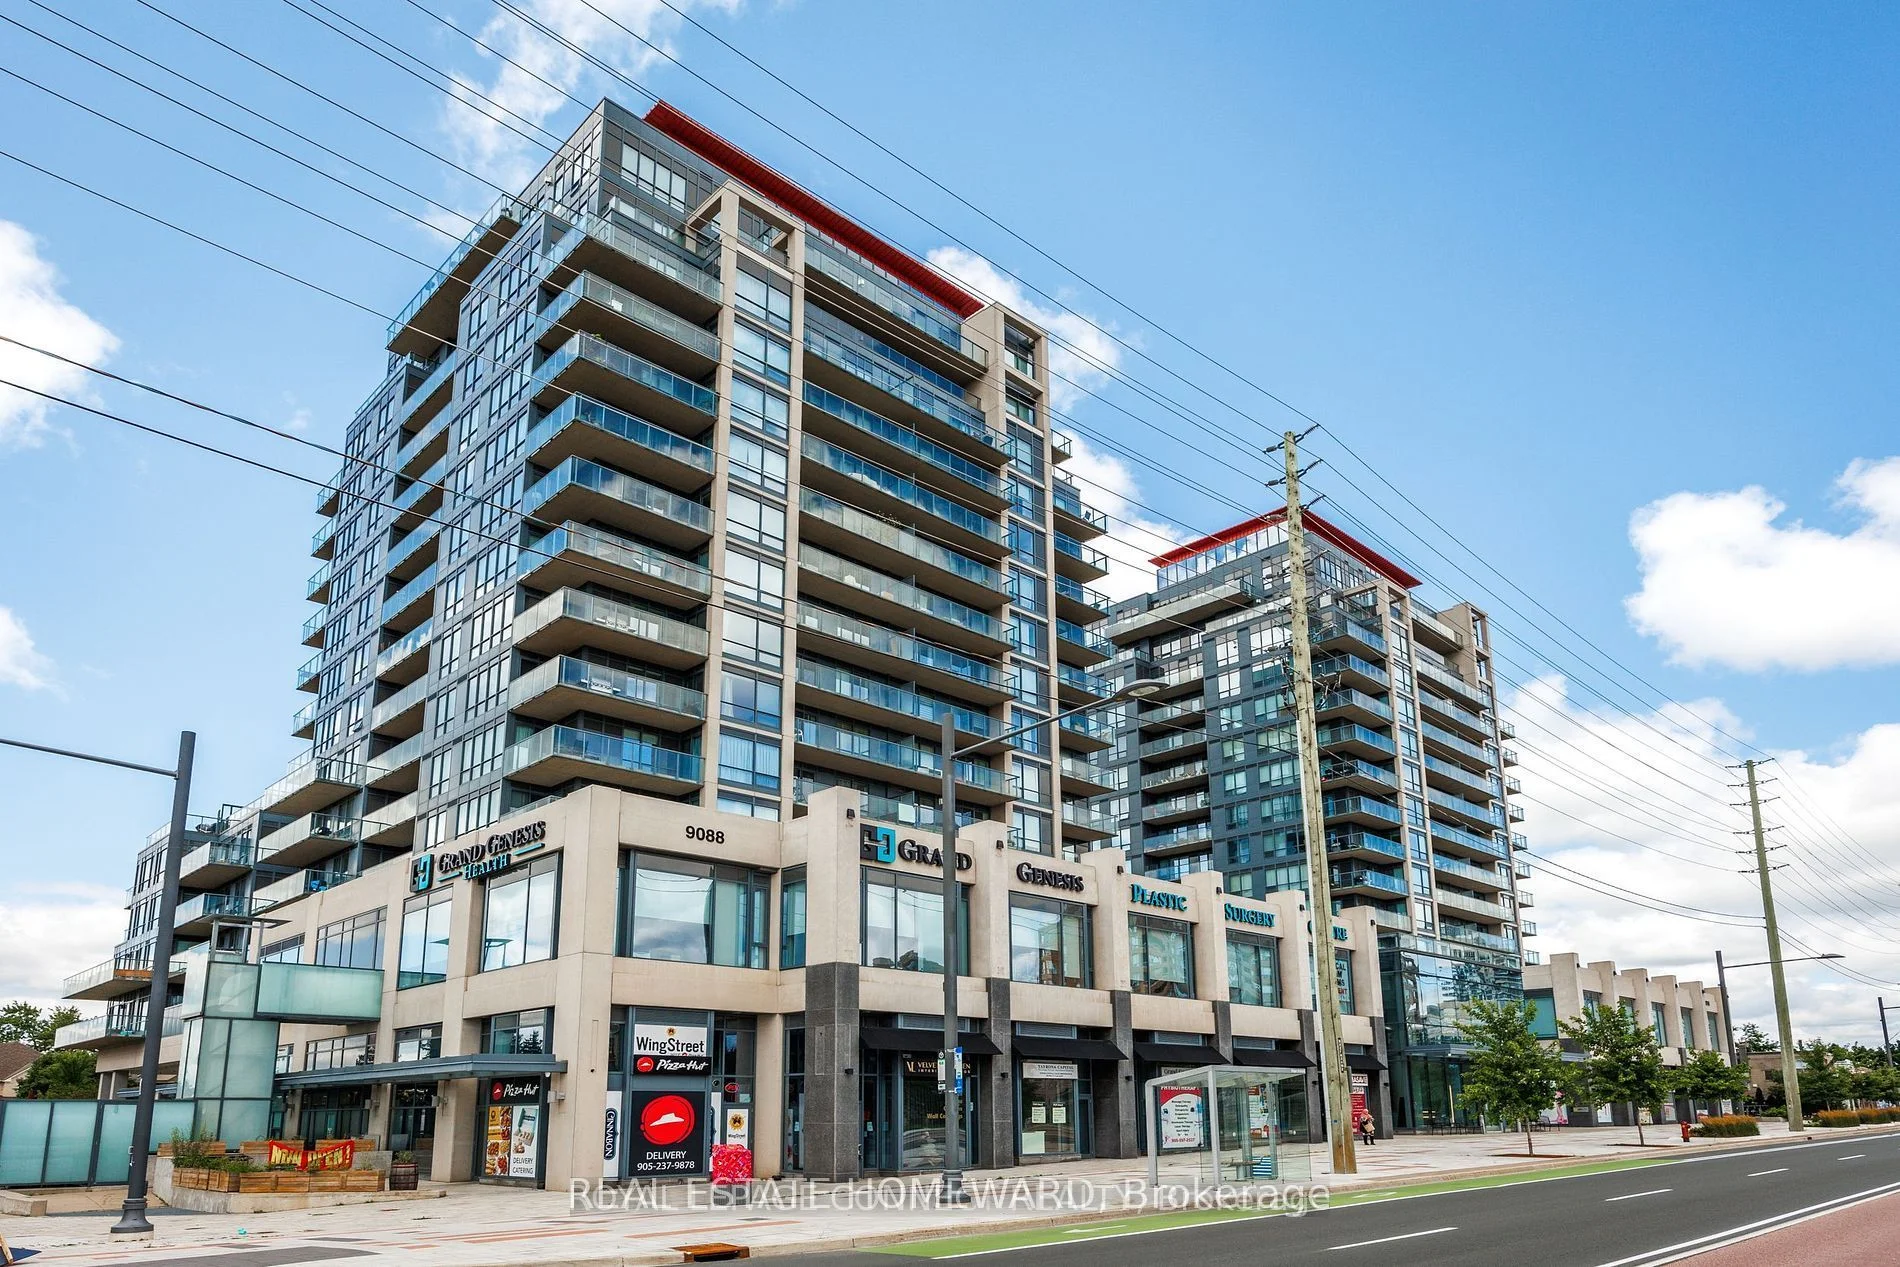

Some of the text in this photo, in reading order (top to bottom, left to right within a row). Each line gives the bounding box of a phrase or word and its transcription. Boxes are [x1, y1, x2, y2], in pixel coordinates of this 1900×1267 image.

[685, 825, 725, 845] 9088
[437, 821, 546, 873] GRAND GENESIS
[898, 839, 973, 870] GRAD
[462, 853, 511, 881] HEALTH
[1016, 861, 1084, 893] GENESIS
[1131, 883, 1188, 912] PLASTIC
[1224, 902, 1276, 928] SURGERY
[636, 1037, 705, 1054] WingStreet
[656, 1059, 709, 1071] Pizza Hut
[503, 1084, 539, 1097] Pizza Hut
[605, 1110, 616, 1157] CINNABON
[512, 1156, 534, 1165] DELIVERY
[637, 1160, 695, 1171] 905-237-9878
[646, 1151, 687, 1160] DELIVERY
[512, 1167, 534, 1175] CATERING
